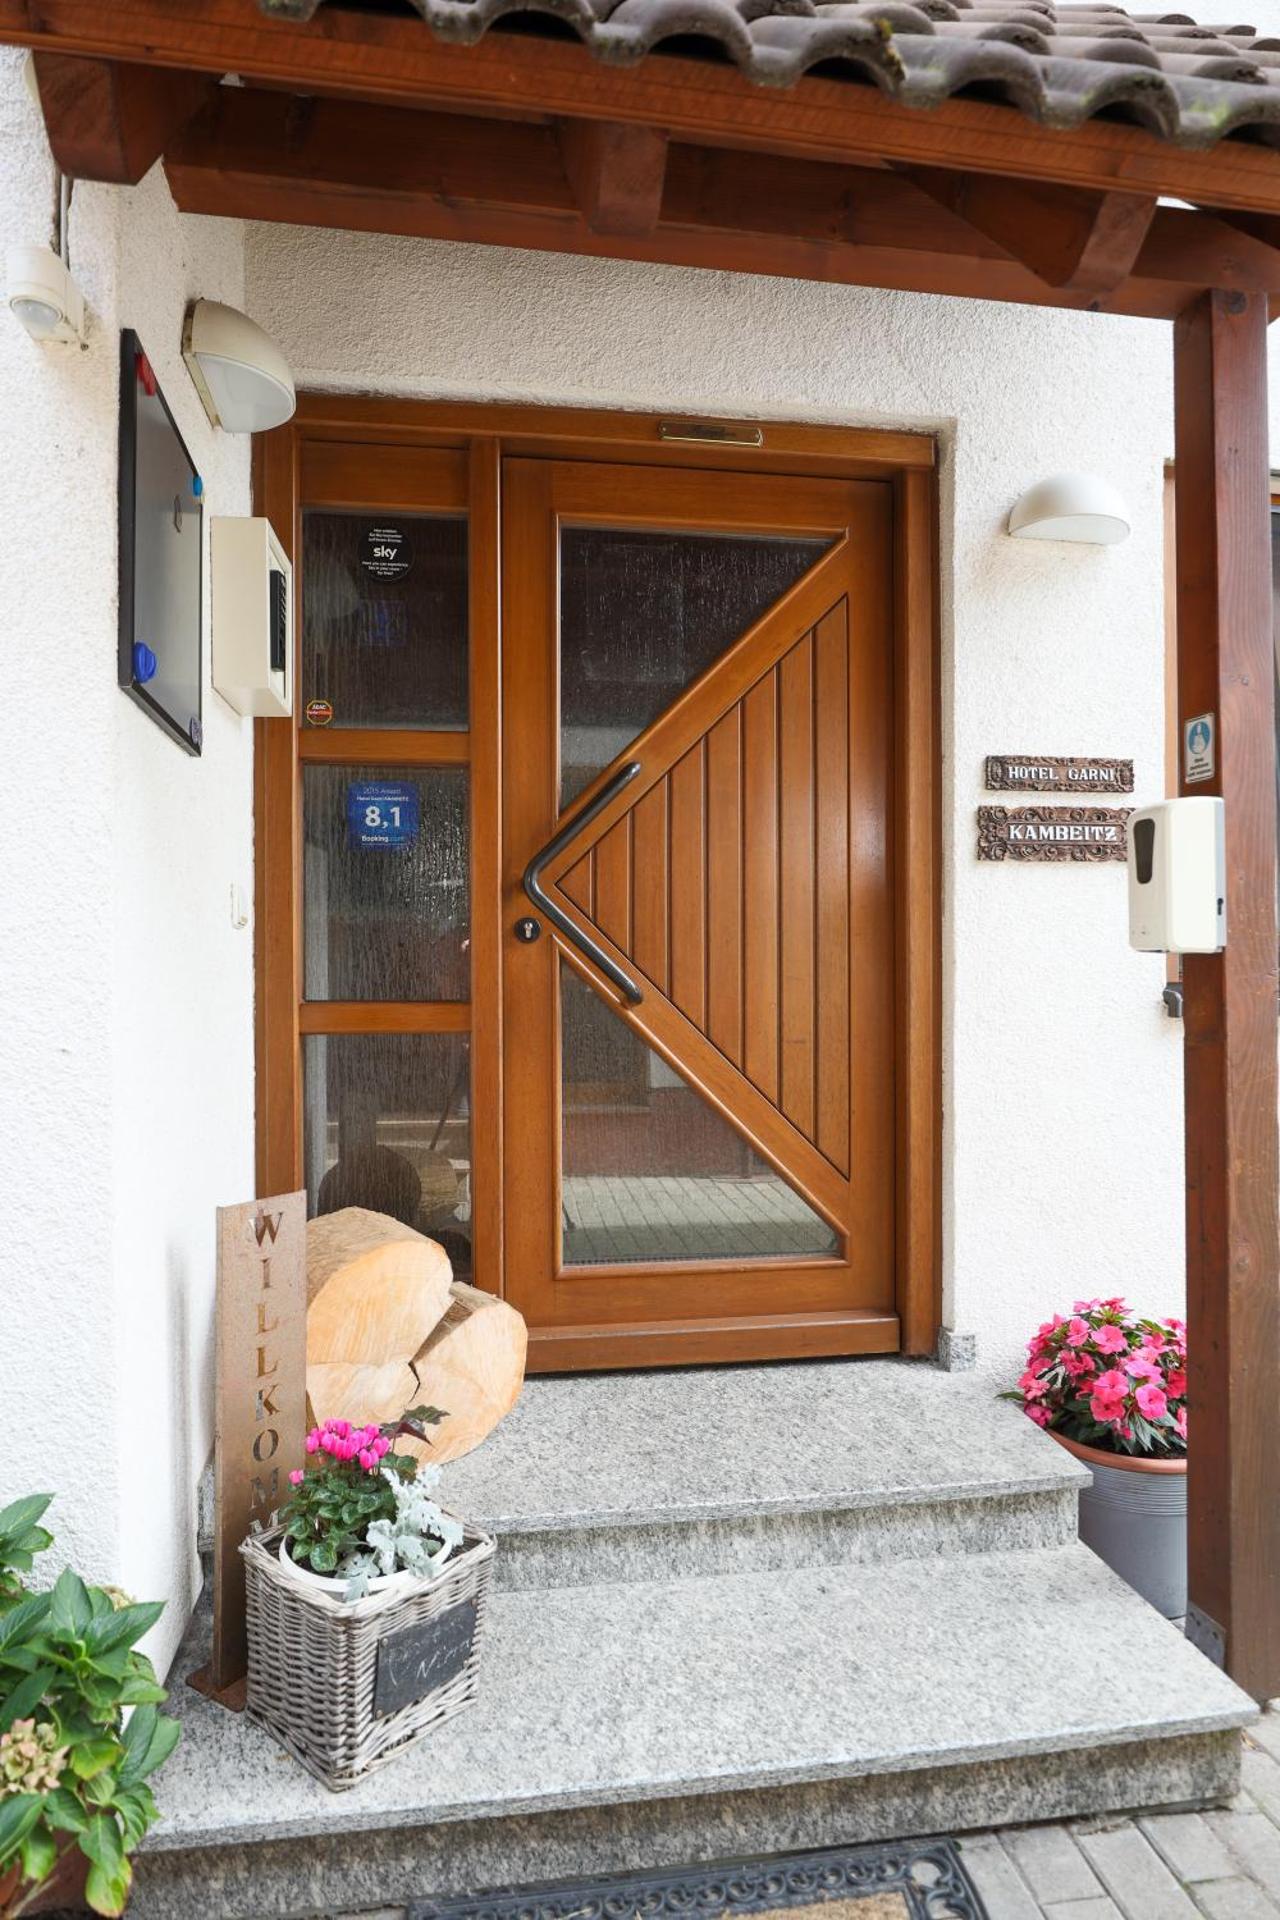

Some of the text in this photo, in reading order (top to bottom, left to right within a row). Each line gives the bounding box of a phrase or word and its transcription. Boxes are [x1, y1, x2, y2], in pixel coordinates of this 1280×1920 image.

[373, 545, 398, 560] sky
[1008, 766, 1116, 782] HOTEL GARNI
[365, 805, 401, 829] 8,1
[1009, 824, 1118, 842] KAMBEITZ
